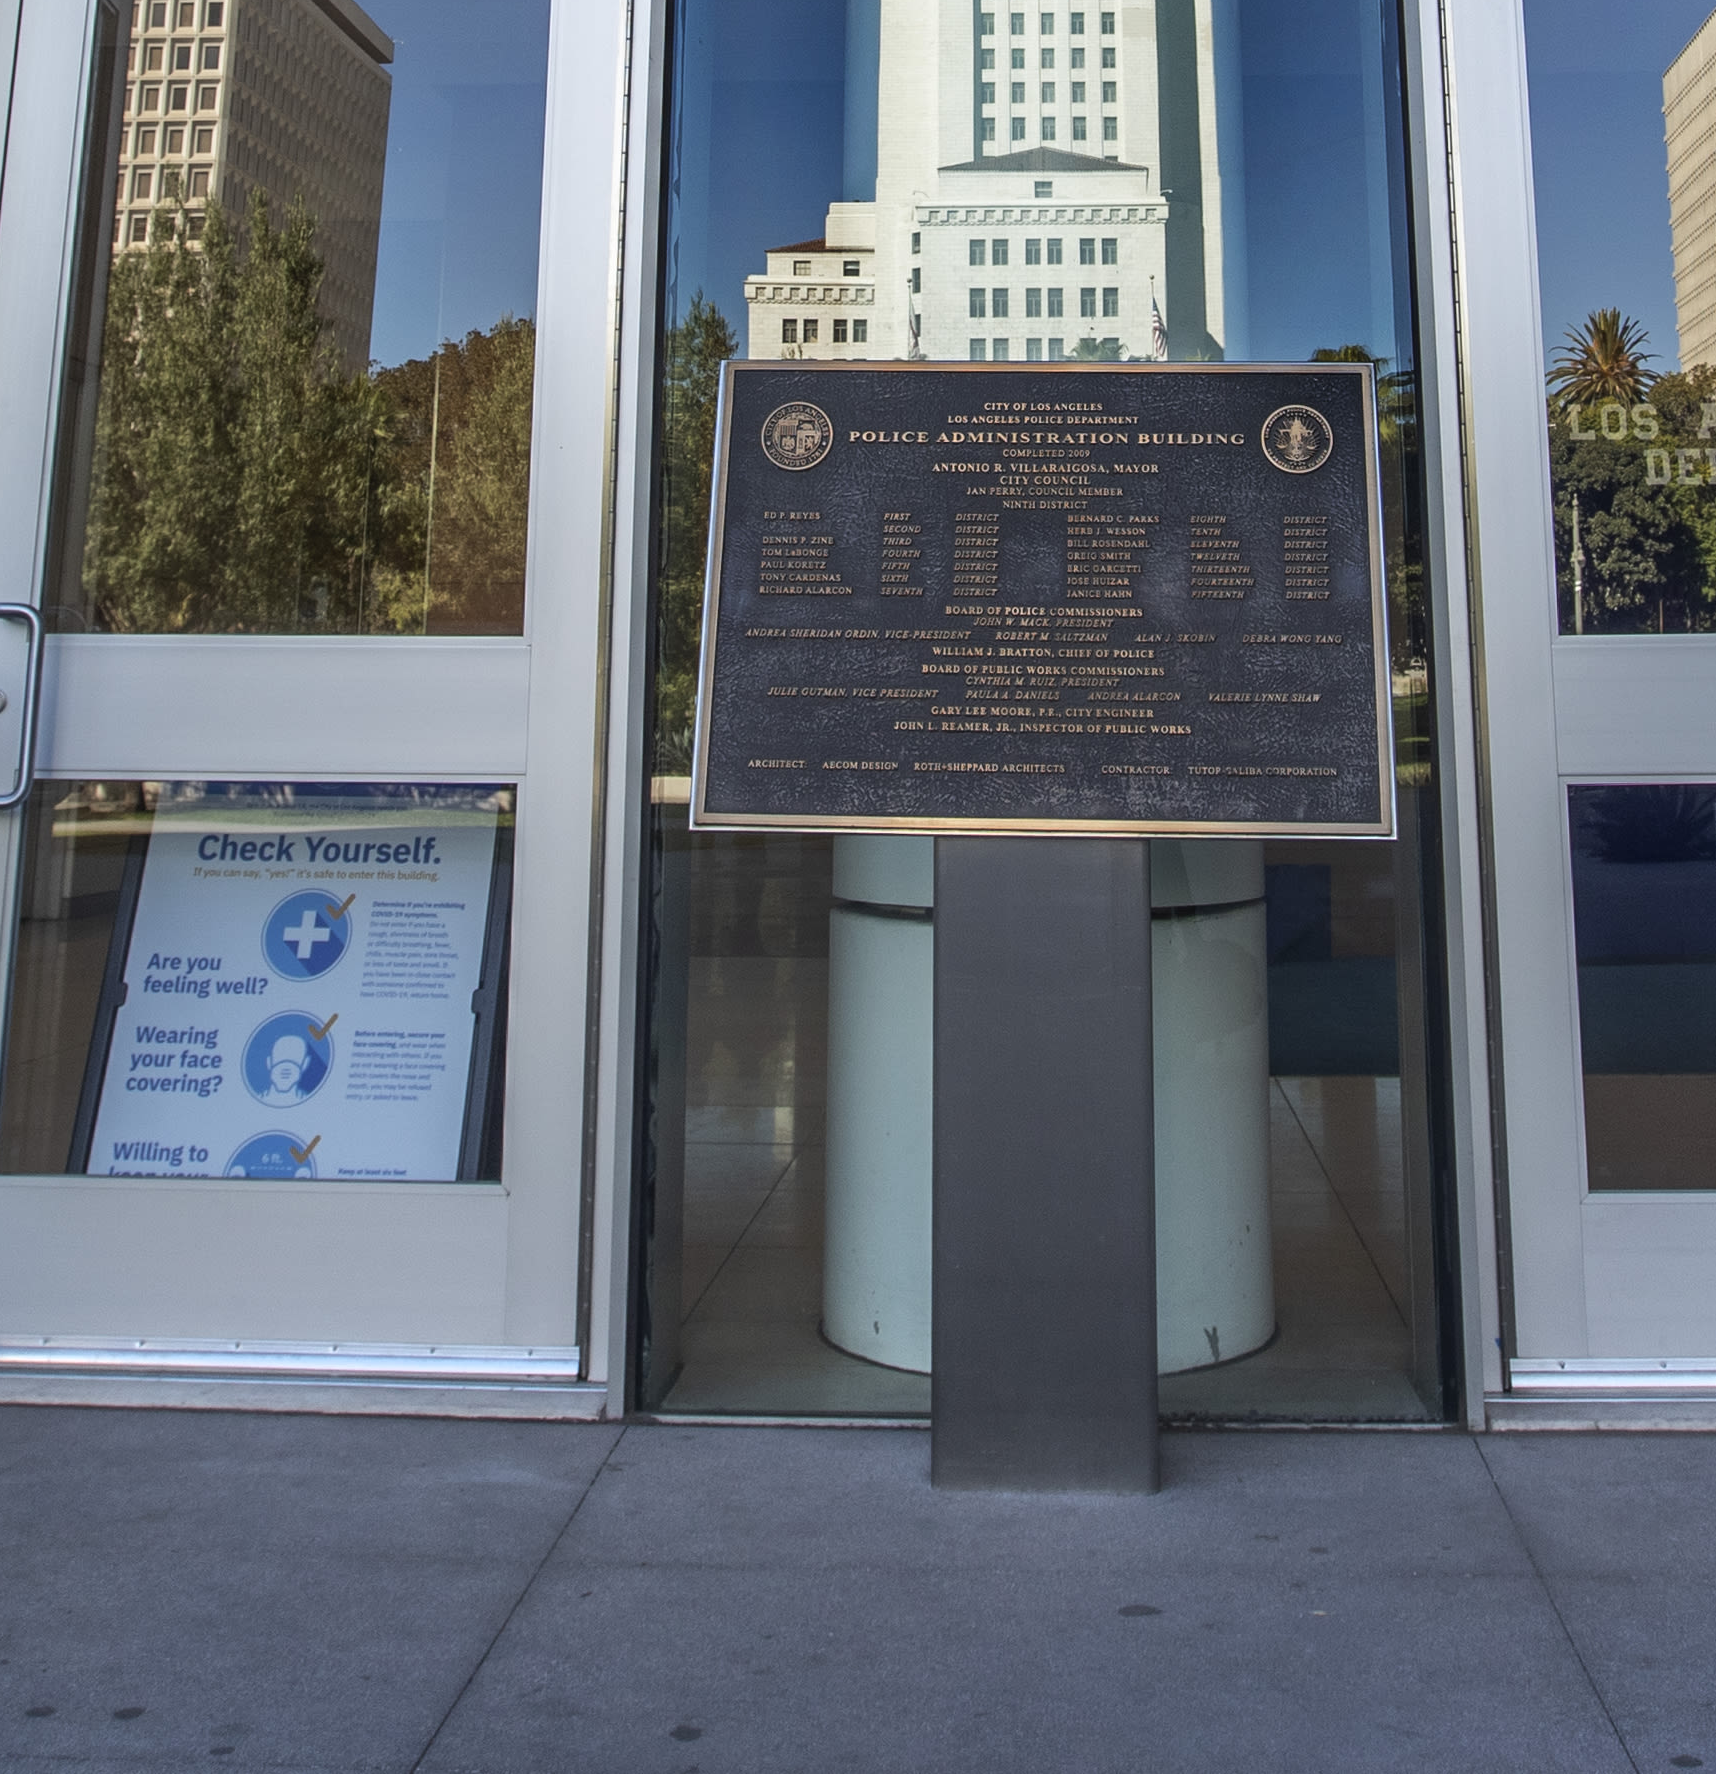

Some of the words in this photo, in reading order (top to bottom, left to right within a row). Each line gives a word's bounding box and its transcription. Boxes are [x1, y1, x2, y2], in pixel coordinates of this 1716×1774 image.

[983, 402, 1010, 411] CITY
[1030, 402, 1051, 411] LOS
[1053, 402, 1103, 411] ANGELES
[947, 415, 968, 424] LOS
[970, 415, 1020, 424] ANGELES
[1023, 415, 1063, 424] POLICE
[1066, 415, 1139, 424] DEPARTMENT
[1567, 402, 1660, 441] LOS
[849, 431, 928, 443] POLICE
[936, 431, 1128, 444] ADMINISTRATION
[1137, 432, 1244, 444] BUILDING
[1002, 448, 1065, 457] COMPLETED
[1068, 448, 1090, 457] 2009
[932, 462, 990, 473] ANTONIO
[1010, 462, 1109, 473] VILLARAIGOSA,
[1113, 463, 1159, 473] MAYOR
[999, 475, 1028, 485] CITY
[1033, 475, 1090, 485] COUNCIL
[966, 486, 987, 495] JAN
[989, 486, 1025, 496] PERRY,
[1028, 486, 1074, 496] COUNCIL
[1078, 487, 1123, 496] MEMBER
[1002, 499, 1036, 509] NINTH
[1039, 500, 1088, 509] DISTRICT
[883, 512, 911, 520] FIRST
[954, 512, 999, 521] DISTRICT
[1189, 514, 1227, 524] EIGHTH
[1282, 515, 1328, 524] DISTRICT
[882, 524, 921, 533] SECOND
[954, 525, 1000, 534] DISTRICT
[1191, 527, 1221, 536] TENTH
[1283, 528, 1328, 536] DISTRICT
[762, 535, 798, 544] DENNIS
[810, 535, 834, 544] ZINE
[883, 536, 912, 546] THIRD
[954, 537, 999, 546] DISTRICT
[1283, 540, 1328, 549] DISTRICT
[761, 548, 782, 556] TOM
[881, 548, 921, 558] FOURTH
[953, 549, 998, 558] DISTRICT
[1283, 552, 1328, 561] DISTRICT
[760, 560, 785, 569] PAUL
[881, 561, 911, 570] FIFTH
[953, 562, 998, 571] DISTRICT
[1284, 565, 1329, 574] DISTRICT
[760, 572, 786, 581] TONY
[788, 572, 841, 582] CARDENAS
[881, 573, 909, 582] SIXTH
[952, 574, 998, 583] DISTRICT
[1066, 576, 1089, 585] JOSE
[1092, 576, 1130, 586] HUIZAR
[1285, 577, 1330, 587] DISTRICT
[758, 585, 803, 594] RICHARD
[805, 585, 852, 595] ALARCON
[880, 586, 923, 595] SEVENTH
[952, 587, 998, 596] DISTRICT
[1066, 589, 1100, 598] JANICE
[1104, 589, 1132, 598] HAHN
[1285, 590, 1330, 599] DISTRICT
[945, 606, 983, 615] BOARD
[1004, 606, 1045, 616] POLICE
[1049, 606, 1143, 617] COMMISSIONERS
[932, 647, 984, 656] WILLIAM
[999, 647, 1055, 657] BRATTON,
[1058, 648, 1091, 657] CHIEF
[1113, 648, 1155, 658] POLICE
[921, 664, 961, 674] BOARD
[981, 665, 1022, 674] PUBLIC
[1026, 665, 1067, 675] WORKS
[1070, 665, 1165, 676] COMMISSIONERS
[930, 705, 961, 715] GARY
[965, 706, 987, 716] LEE
[990, 706, 1035, 716] MOORE,
[1065, 707, 1093, 717] CITY
[1095, 708, 1154, 718] ENGINEER
[893, 720, 924, 731] JOHN
[941, 721, 993, 732] REAMER,
[995, 722, 1016, 732] JR.,
[1019, 722, 1084, 733] INSPECTOR
[1105, 723, 1146, 734] PUBLIC
[1150, 724, 1192, 734] WORKS
[821, 760, 859, 770] AECOM
[860, 760, 899, 770] DESIGN
[1001, 762, 1065, 772] ARCHITECTS
[198, 834, 295, 862] Check
[305, 836, 441, 865] Yourself.
[193, 866, 203, 877] If
[203, 868, 223, 879] you
[224, 869, 241, 877] can
[313, 869, 334, 879] safe
[336, 870, 347, 880] to
[349, 871, 374, 880] enter
[377, 870, 395, 881] this
[147, 952, 182, 971] Are
[186, 956, 222, 975] you
[143, 976, 211, 998] feeling
[215, 976, 268, 996] well?
[136, 1026, 219, 1050] Wearing
[129, 1052, 175, 1074] your
[180, 1051, 223, 1069] face
[125, 1074, 223, 1098] covering?
[113, 1141, 184, 1165] Willing
[189, 1144, 209, 1163] to
